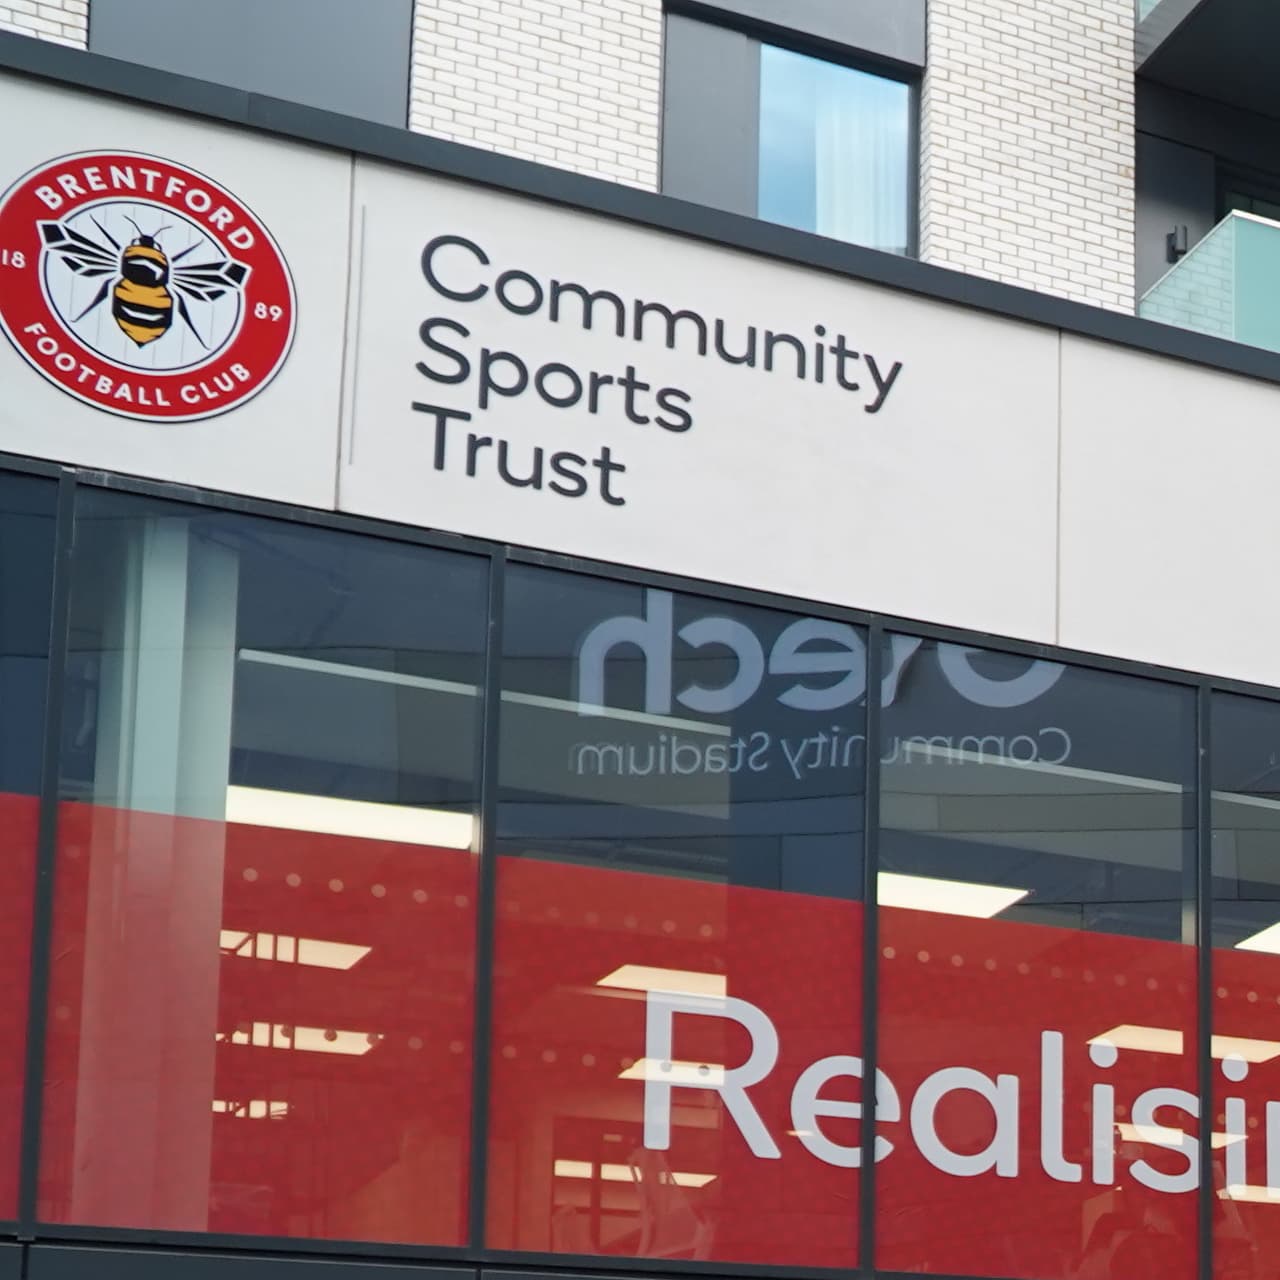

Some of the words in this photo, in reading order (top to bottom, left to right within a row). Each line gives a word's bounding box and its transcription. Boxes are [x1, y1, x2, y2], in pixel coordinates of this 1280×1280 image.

[34, 165, 256, 251] BRENTFORD
[1, 249, 26, 269] 18
[253, 302, 283, 322] 89
[420, 234, 903, 414] Community
[24, 321, 172, 407] FOOTBALL
[180, 362, 251, 405] CLUB
[415, 316, 693, 433] Sports
[411, 400, 627, 507] Trust
